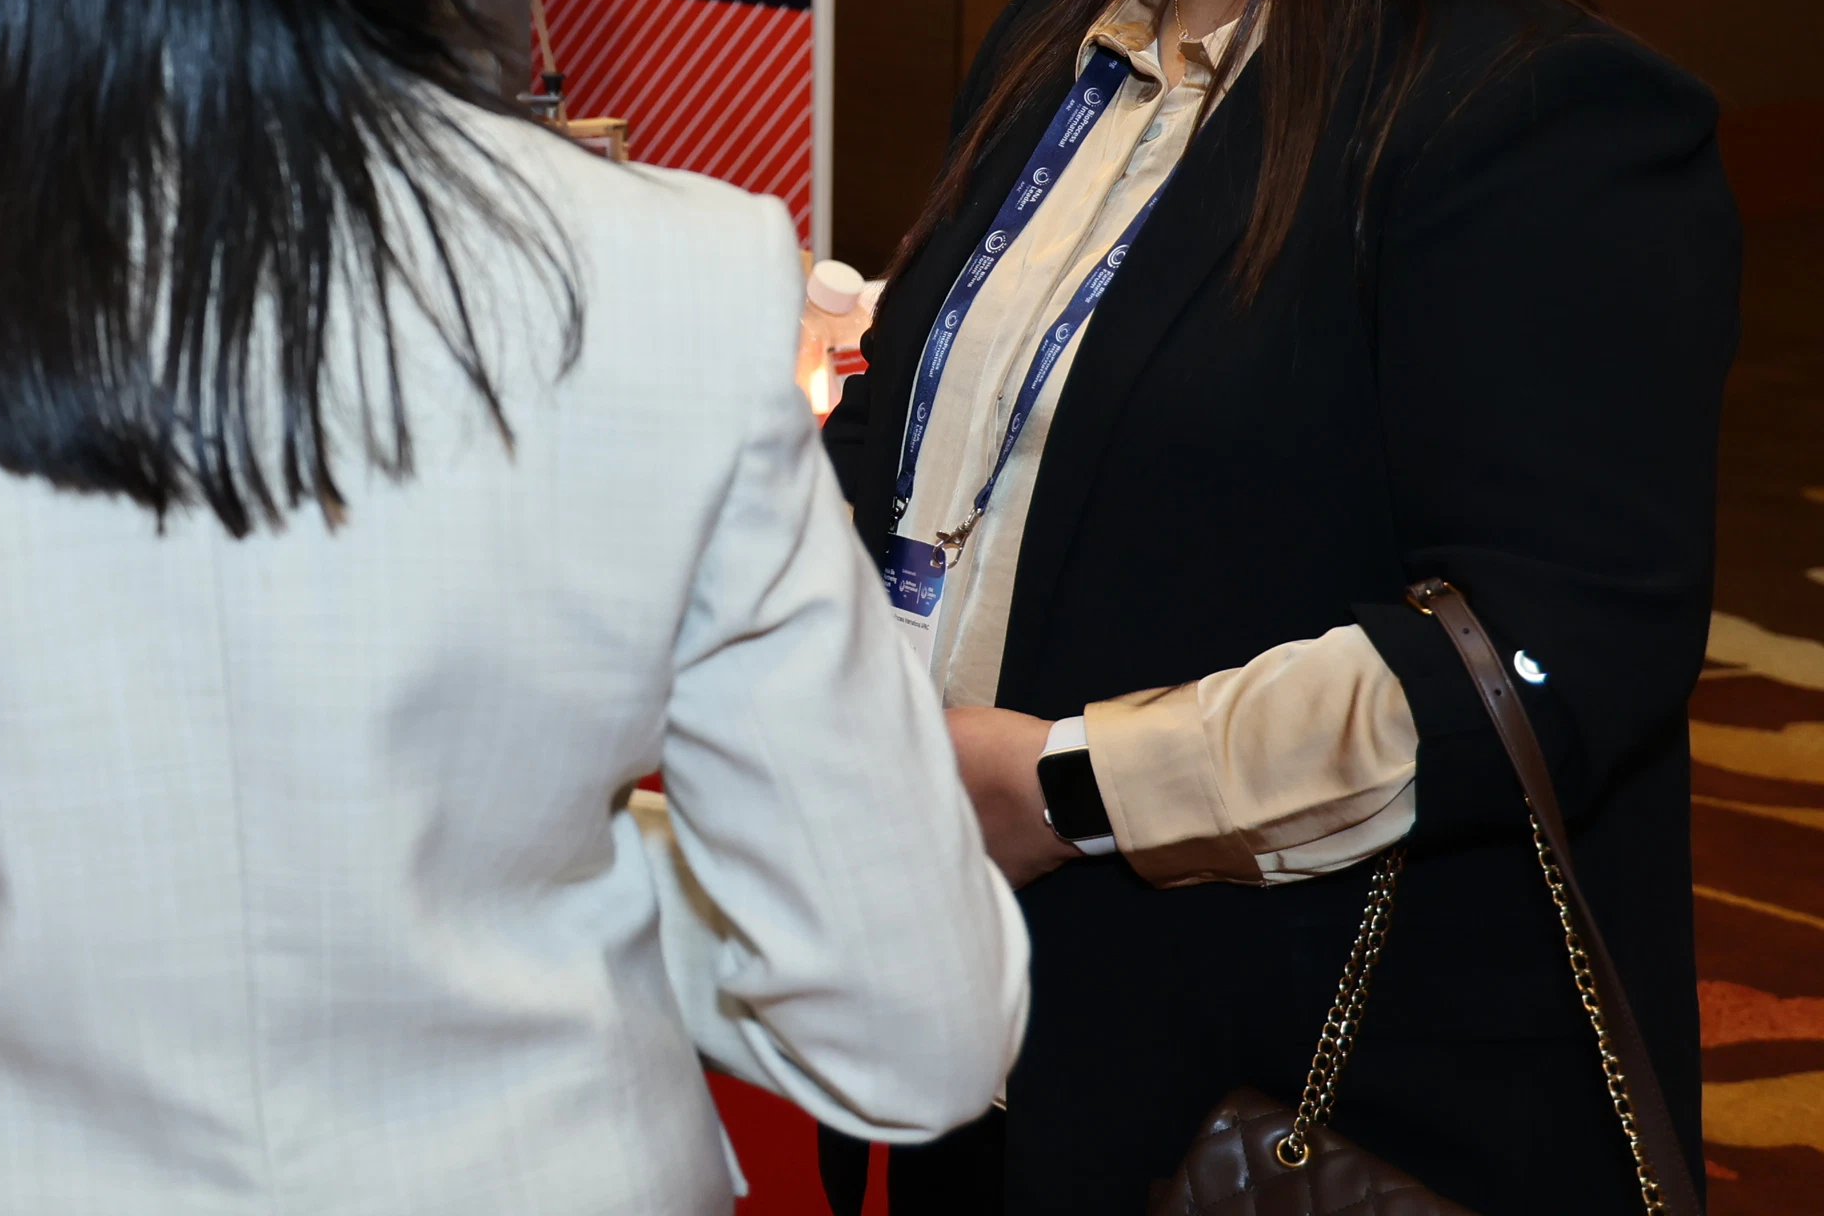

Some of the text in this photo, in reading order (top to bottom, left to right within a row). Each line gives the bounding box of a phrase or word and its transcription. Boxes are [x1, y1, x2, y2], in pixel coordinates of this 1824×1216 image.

[1058, 105, 1089, 148] International
[1068, 109, 1095, 143] BioProcess
[1017, 185, 1038, 211] Leaders
[1030, 188, 1043, 203] RNA
